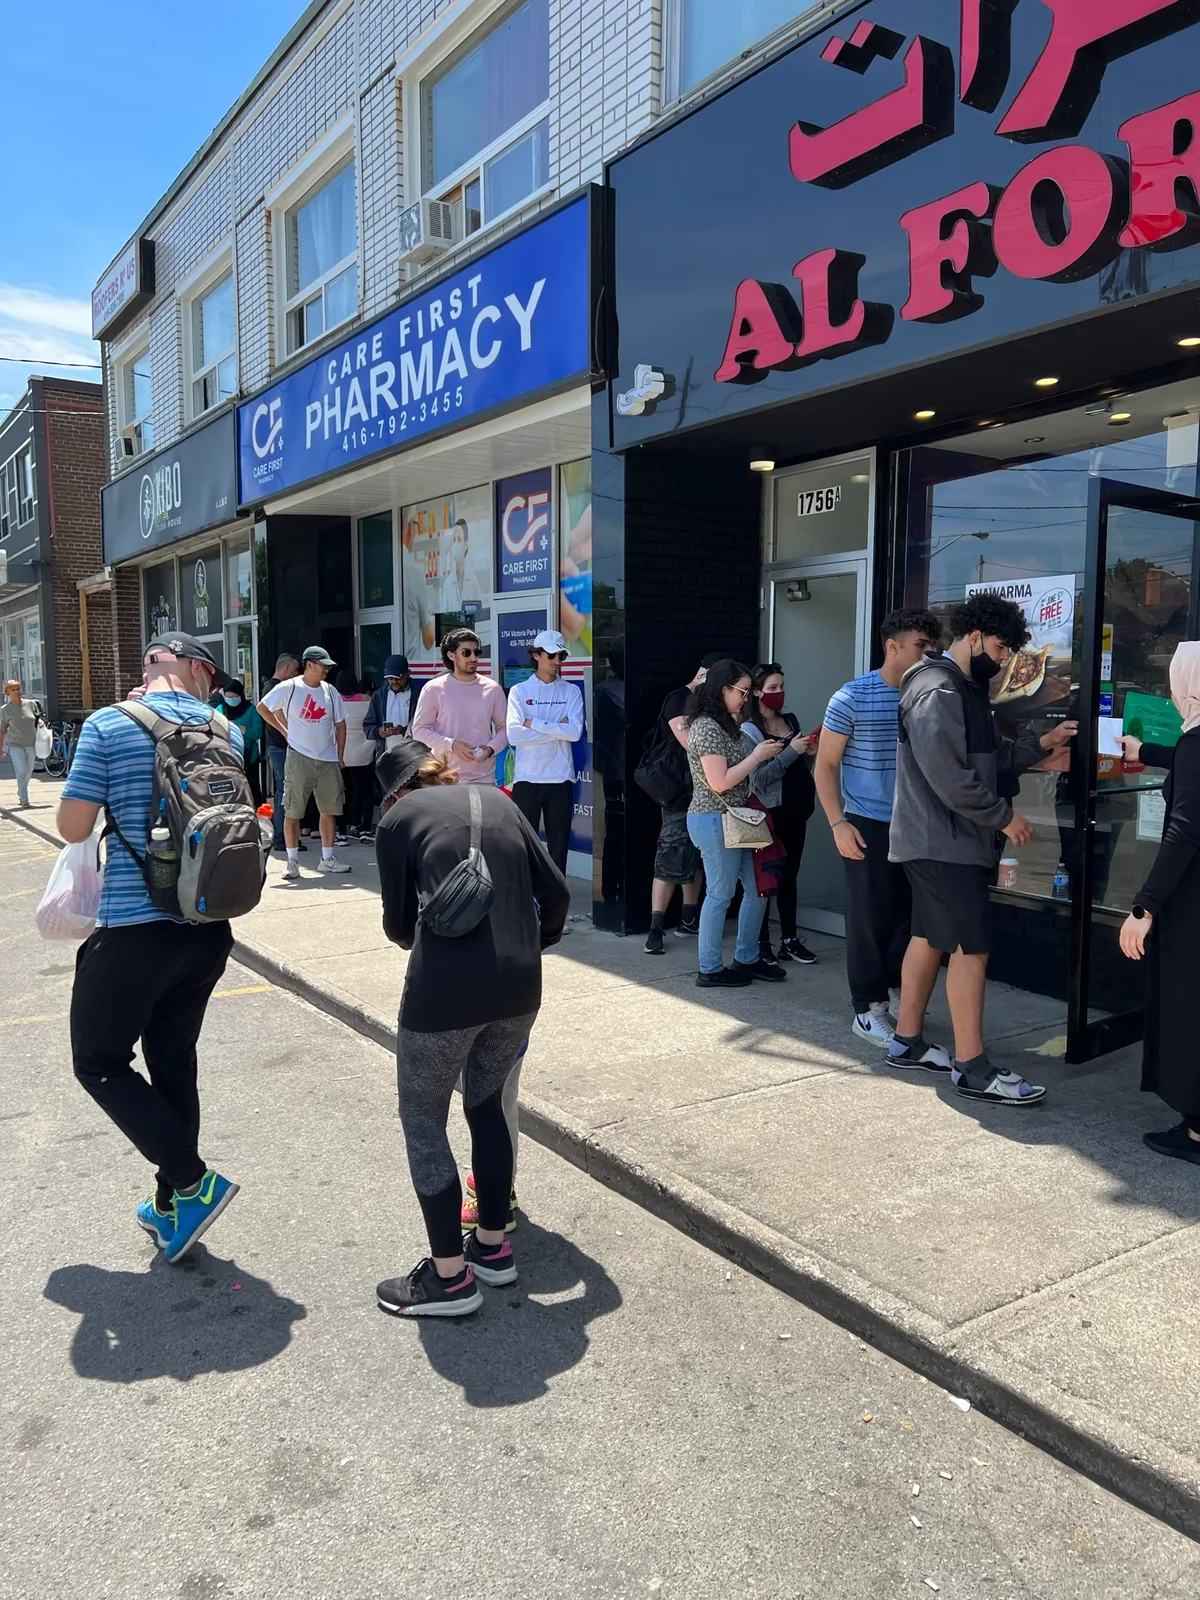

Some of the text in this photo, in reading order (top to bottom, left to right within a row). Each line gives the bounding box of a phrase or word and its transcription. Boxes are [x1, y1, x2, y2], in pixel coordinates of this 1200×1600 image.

[714, 248, 874, 384] AL
[328, 273, 482, 385] CARE FIRST
[305, 278, 547, 450] PHARMACY
[342, 386, 463, 452] 416-792-3455
[253, 457, 283, 478] CARE FIRST
[502, 558, 548, 575] CARE FIRST
[512, 575, 537, 584] PHARMACY
[1039, 600, 1063, 622] FREE
[511, 629, 526, 637] Victoria
[526, 628, 536, 637] Park
[525, 698, 567, 707] Champion
[576, 770, 592, 783] ALL
[573, 803, 594, 817] FAST
